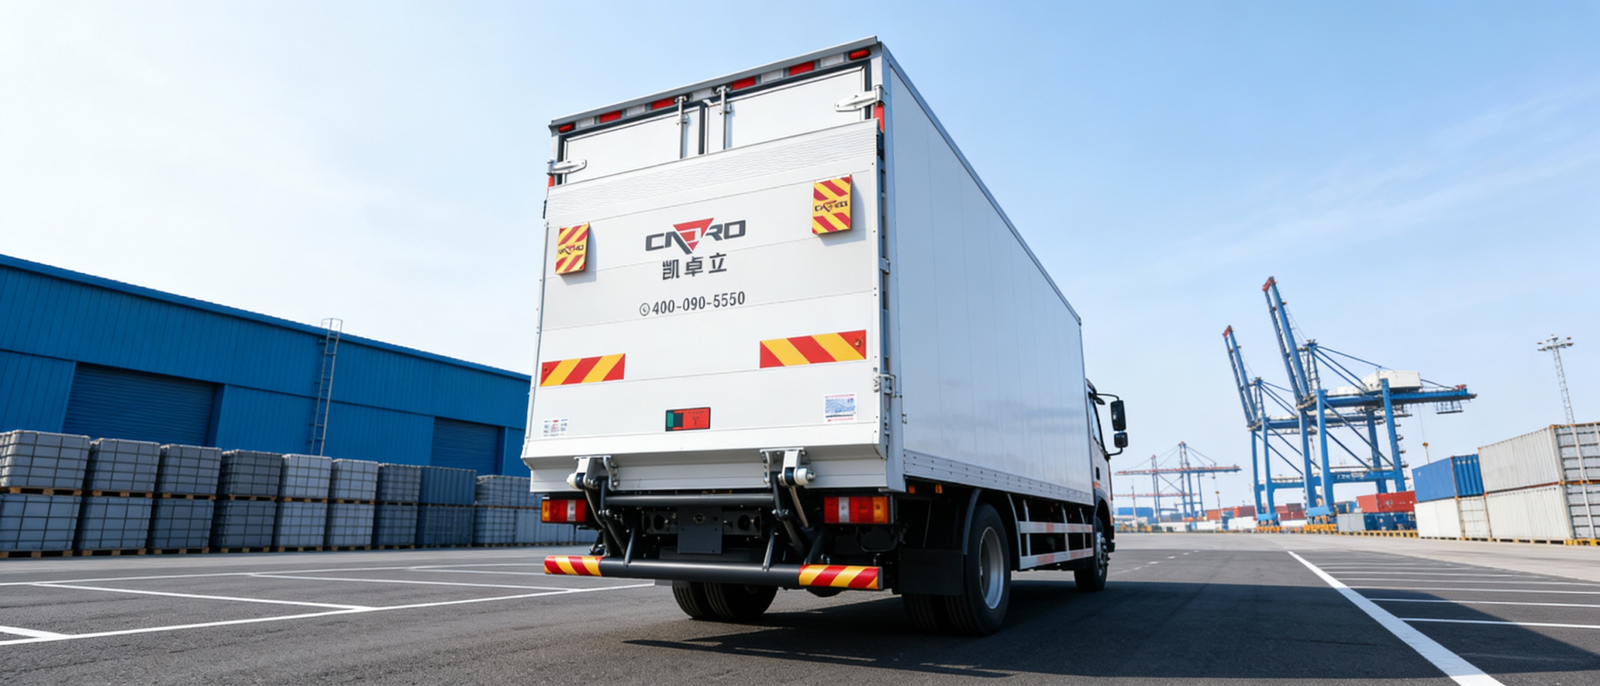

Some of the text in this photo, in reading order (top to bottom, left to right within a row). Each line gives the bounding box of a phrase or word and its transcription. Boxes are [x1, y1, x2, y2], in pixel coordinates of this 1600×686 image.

[662, 252, 727, 280] 凯卓立
[652, 291, 745, 315] 400-090-5550
